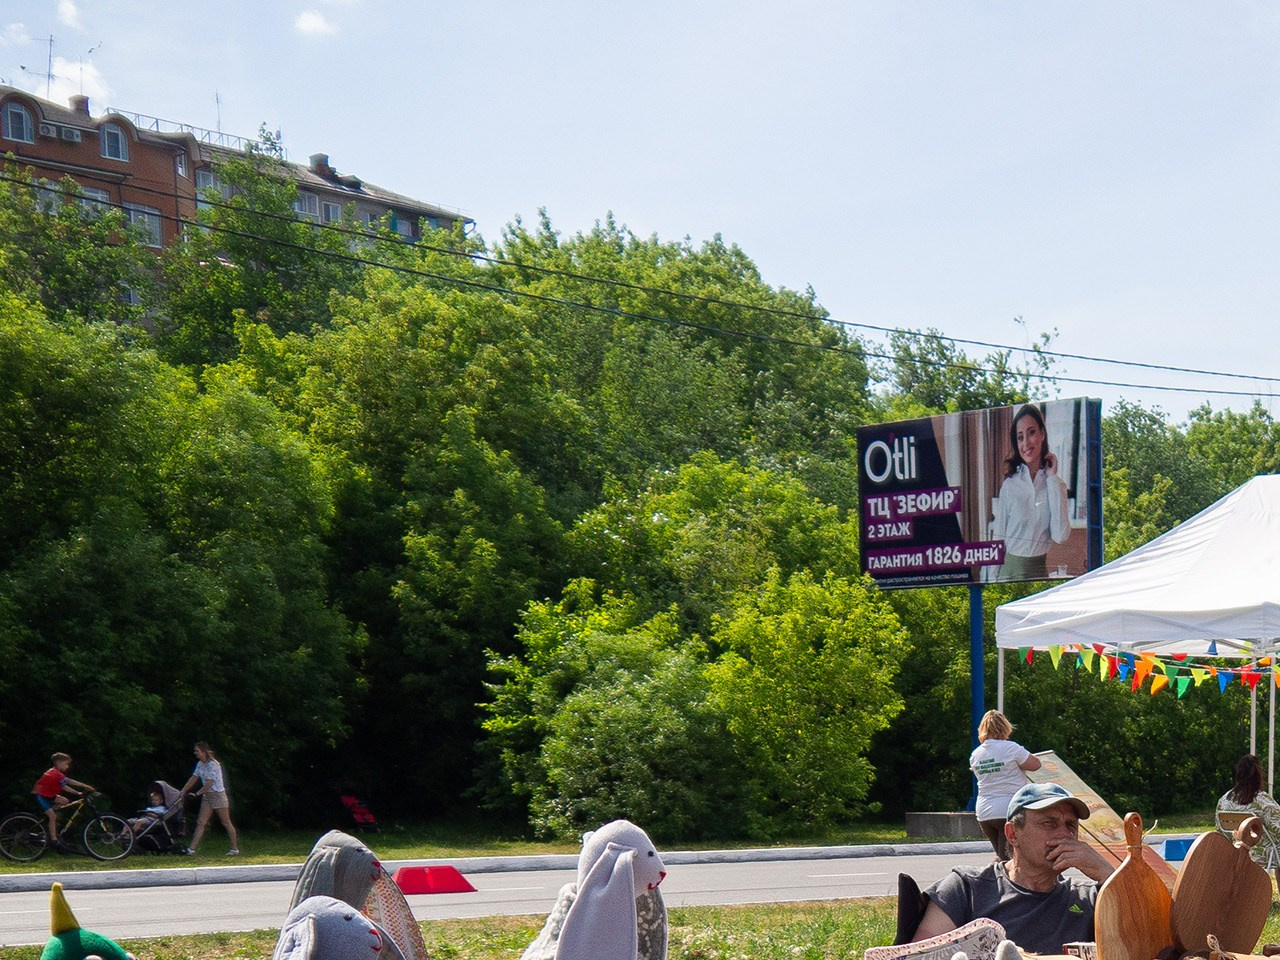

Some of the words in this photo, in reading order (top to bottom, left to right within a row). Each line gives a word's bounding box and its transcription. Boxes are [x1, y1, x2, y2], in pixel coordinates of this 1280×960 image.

[867, 497, 891, 519] ТЦ
[868, 525, 876, 539] 2
[877, 522, 911, 538] ЭТАЖ
[868, 552, 923, 569] ГАРАНТИЯ
[925, 545, 962, 565] 1826
